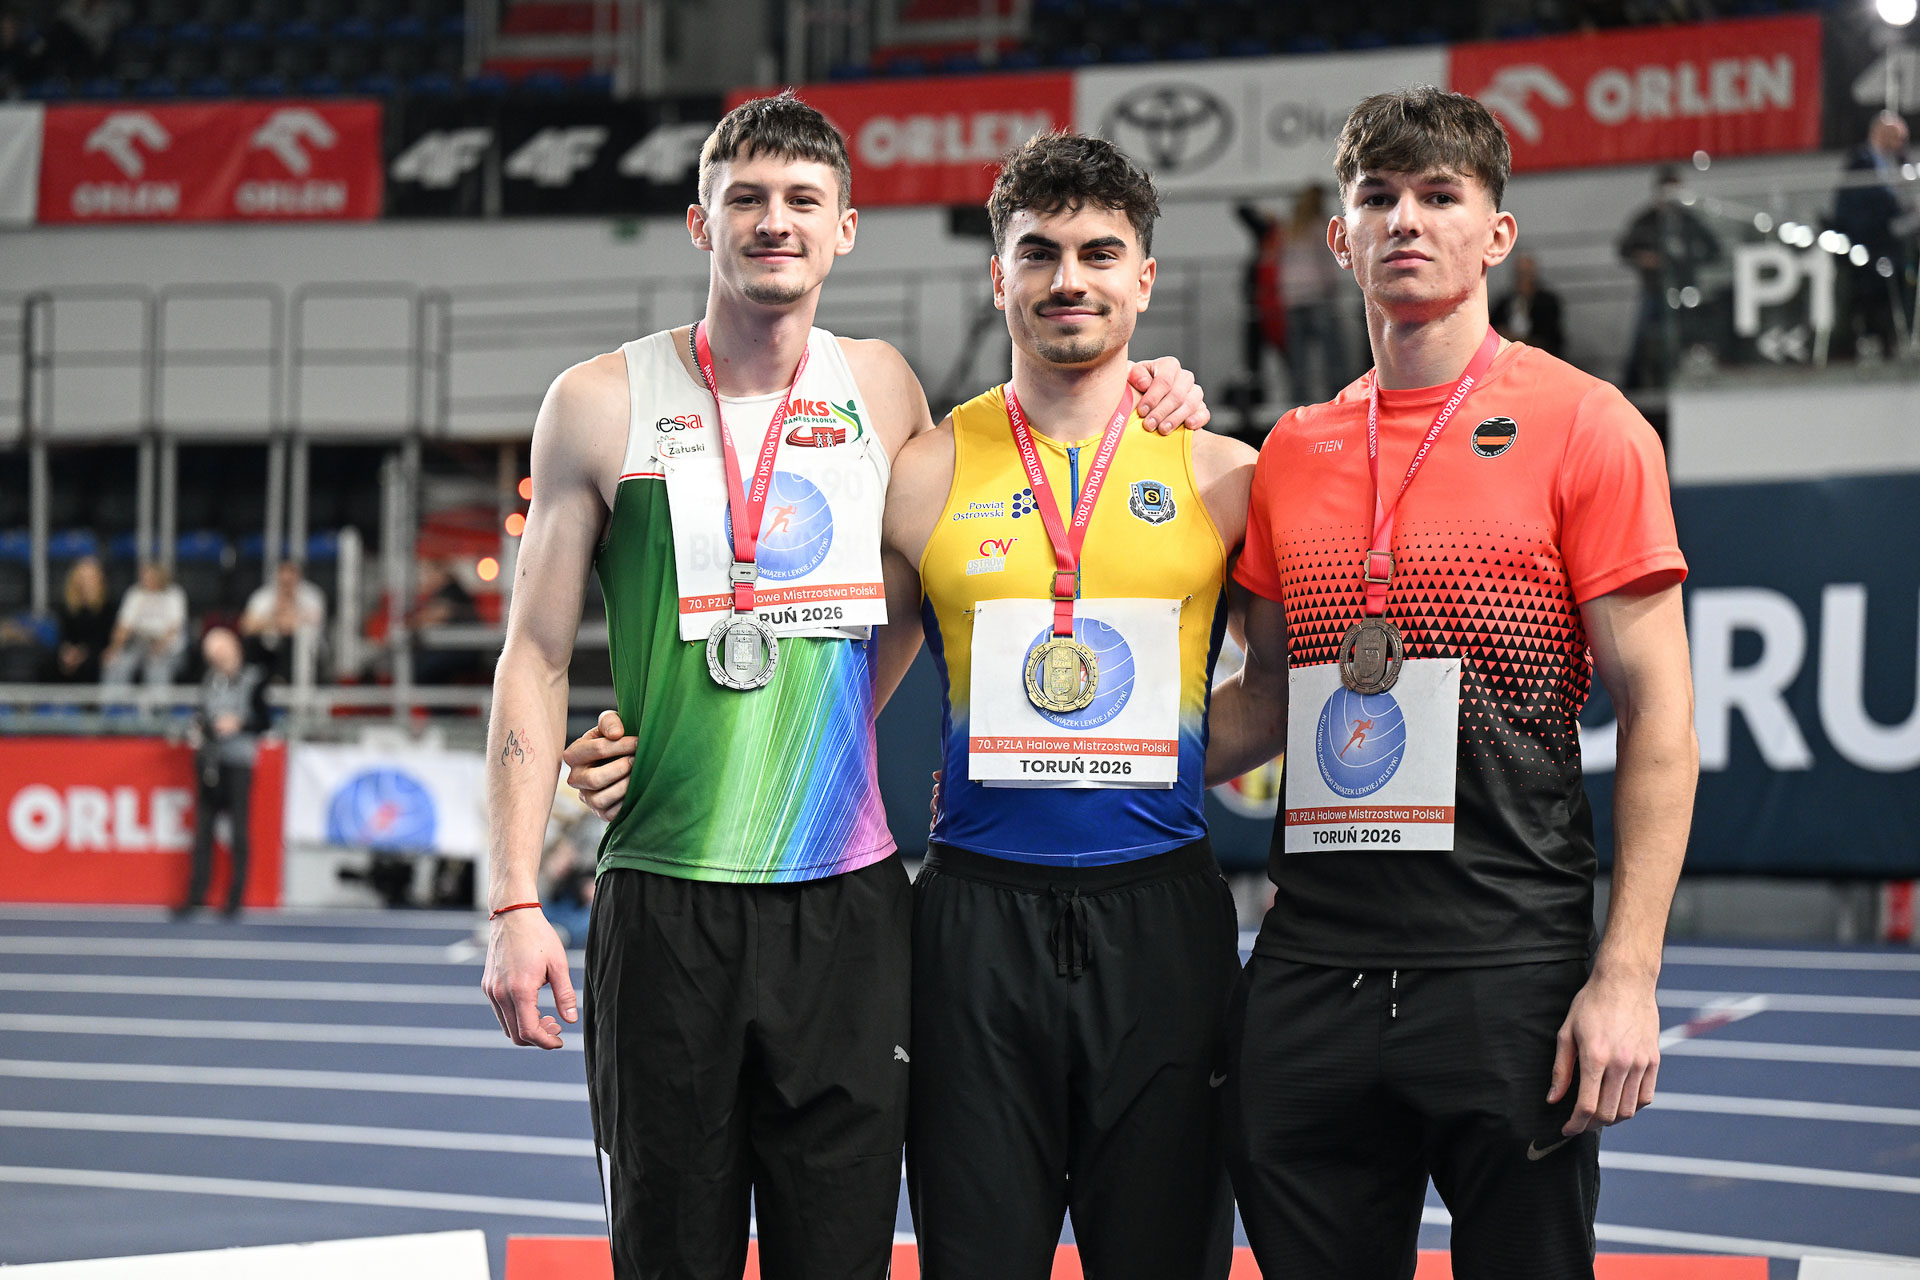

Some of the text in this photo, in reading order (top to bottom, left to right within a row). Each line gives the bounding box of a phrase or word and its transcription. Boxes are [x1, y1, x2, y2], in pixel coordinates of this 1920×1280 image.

[1585, 54, 1794, 124] ORLEN
[392, 128, 494, 188] 4F
[504, 126, 608, 186] 4F
[70, 183, 181, 214] ORLEN
[233, 178, 348, 212] ORLEN
[1733, 240, 1837, 338] P1
[784, 398, 830, 418] MKS
[1407, 374, 1475, 477] MISTRZOSTWA POLSKI
[758, 441, 776, 477] POLSKI
[1015, 423, 1045, 486] MISTRZOSTWA
[1074, 412, 1126, 527] MISTRZOSTWA POLSKI 2026
[752, 477, 767, 502] 2026
[969, 501, 1005, 510] Powiat
[1147, 491, 1158, 502] S
[952, 509, 1004, 521] Ostrowski
[788, 562, 813, 577] LEKKIEJ
[812, 537, 829, 565] ATLETYKI
[688, 585, 877, 609] 70. PZLA lowe Mistrzostwa Polski
[759, 606, 843, 624] RUŃ 2026
[1080, 713, 1108, 727] LEKKIEJ
[1106, 690, 1128, 717] ATLETYKI
[977, 739, 1171, 753] 70. PZLA Halowe Mistrzostwa Polski
[1019, 757, 1132, 775] TORUŃ 2026
[1355, 781, 1379, 795] LEKKIEJ
[1378, 756, 1399, 783] ATLETYKI
[8, 785, 193, 853] ORLE
[1289, 808, 1445, 822] 70. PZLA Halowe Mistrzostwa Polski
[1313, 826, 1401, 844] TORUŃ 2026
